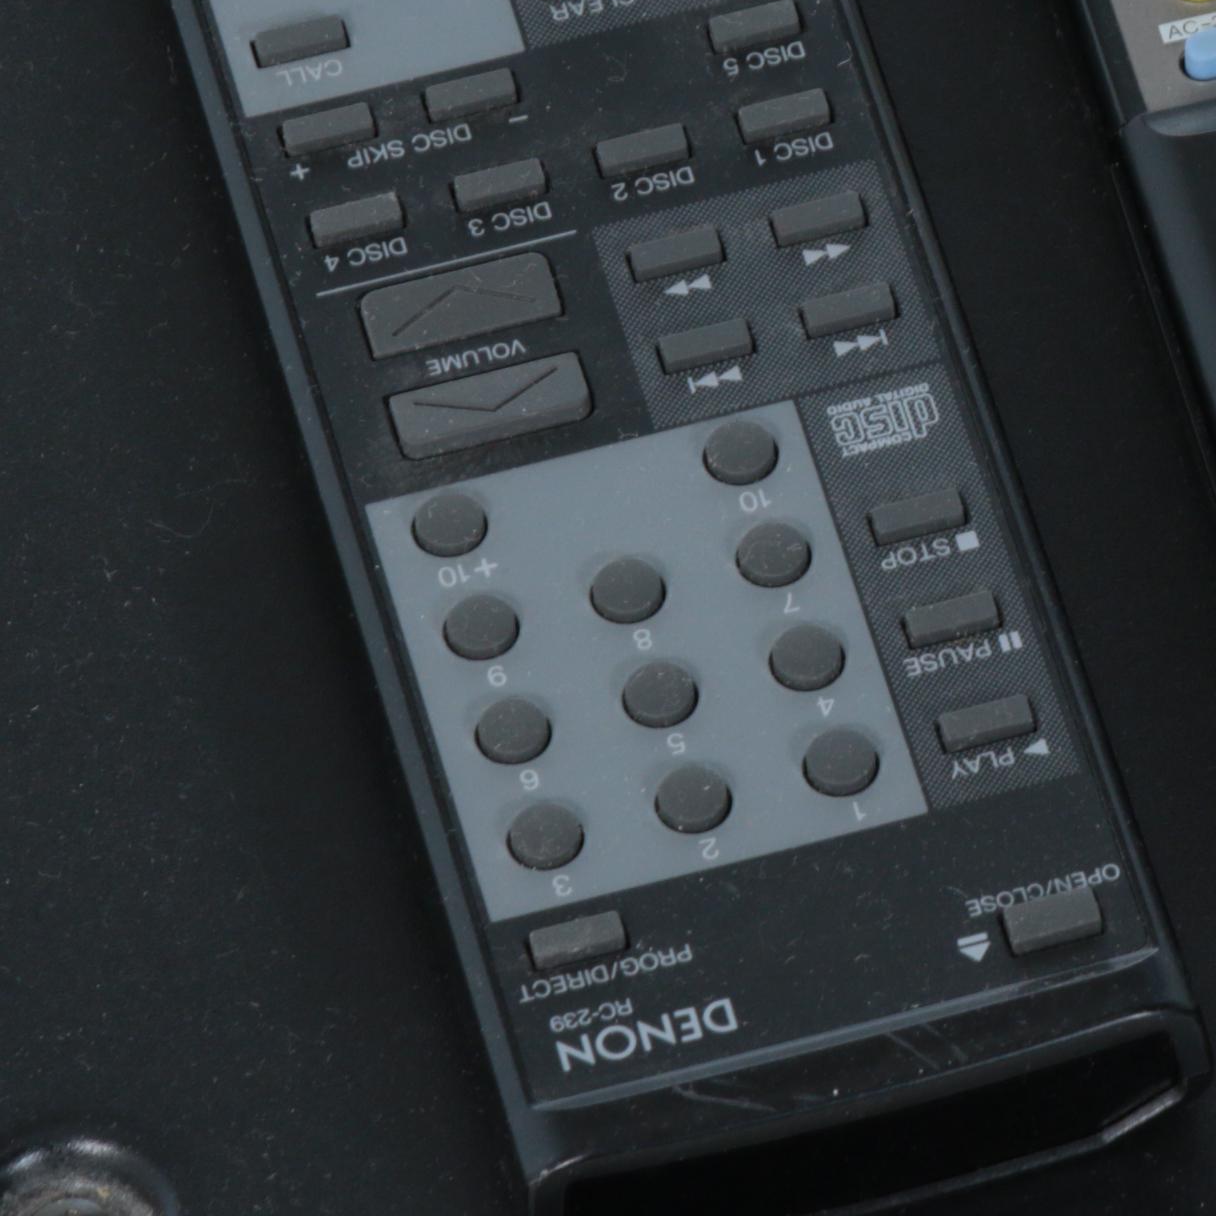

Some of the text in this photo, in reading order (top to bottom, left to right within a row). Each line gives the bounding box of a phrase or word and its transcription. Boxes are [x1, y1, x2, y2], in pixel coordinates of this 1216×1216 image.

[275, 59, 343, 87] CALL
[723, 41, 806, 77] DISC 5
[411, 123, 472, 153] DISC
[754, 132, 834, 167] DISC 1
[347, 139, 405, 169] SKIP
[611, 166, 695, 201] DISC 2
[468, 201, 552, 237] DISC 3
[324, 237, 408, 273] DISC 4
[426, 339, 527, 377] VOLUME
[826, 382, 930, 416] DIGITAL AUDIO
[841, 431, 912, 458] COMPACT
[739, 488, 773, 513] 10
[881, 537, 951, 571] STOP
[437, 557, 499, 588] +10
[782, 592, 801, 614] 7
[633, 629, 653, 651] 8
[487, 665, 507, 687] 9
[903, 644, 992, 677] PAUSE
[817, 696, 835, 718] 4
[667, 733, 686, 755] 5
[951, 747, 1015, 779] PLAY
[519, 768, 540, 791] 6
[852, 801, 866, 821] 1
[699, 837, 720, 861] 2
[552, 874, 573, 897] 3
[965, 863, 1121, 918] OPEN/CLOSE
[518, 943, 694, 1004] PROG/DIRECT
[549, 997, 633, 1033] RC-239
[555, 998, 739, 1073] DENON
